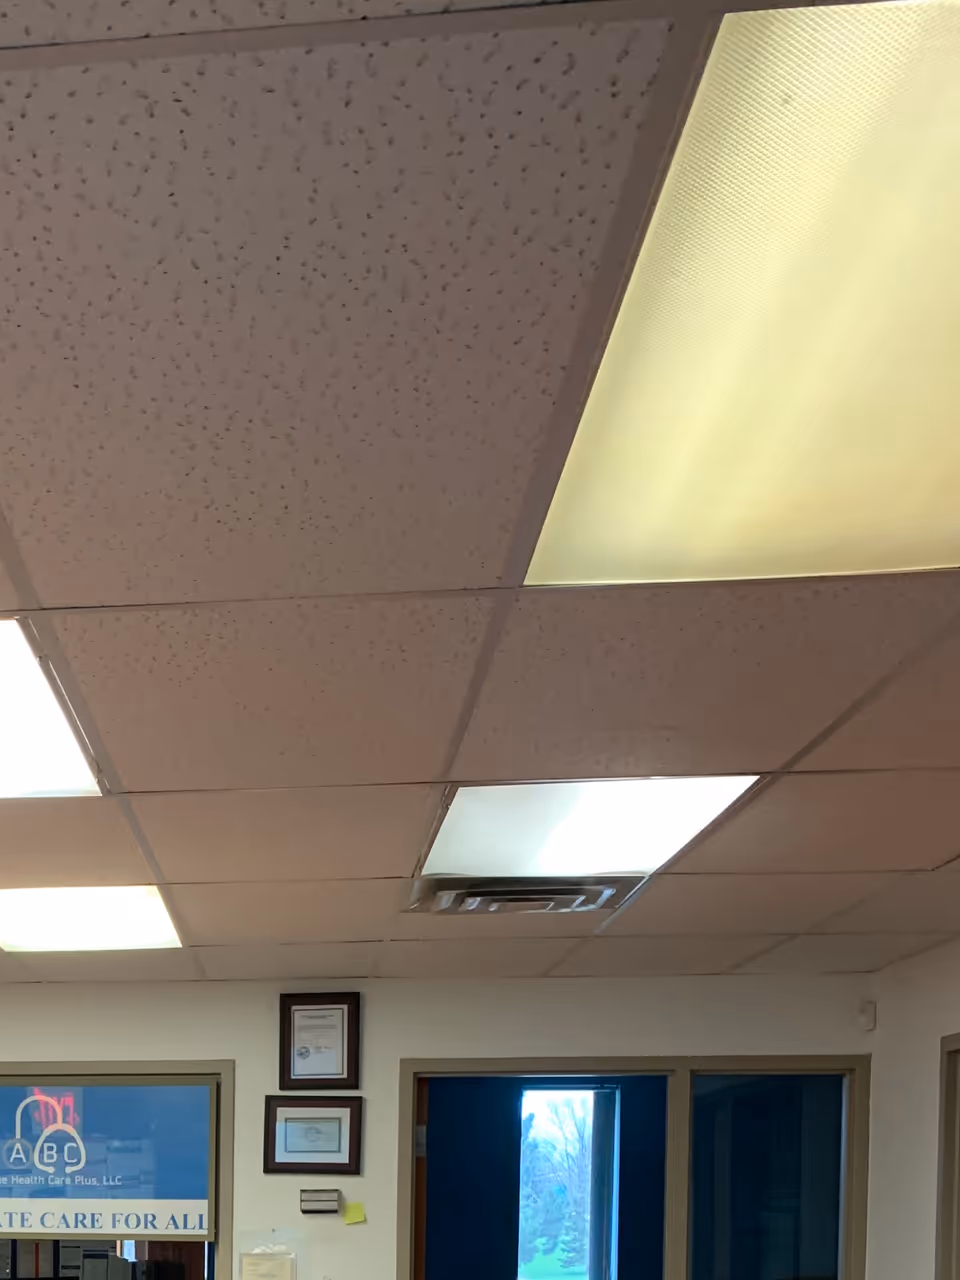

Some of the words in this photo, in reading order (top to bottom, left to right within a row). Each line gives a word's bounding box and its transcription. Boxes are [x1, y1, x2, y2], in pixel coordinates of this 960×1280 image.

[9, 1142, 78, 1164] ABC
[11, 1174, 45, 1185] Health
[47, 1174, 71, 1186] Care
[74, 1175, 100, 1187] Plus,
[102, 1175, 123, 1186] LLC
[40, 1211, 103, 1229] CARE
[111, 1212, 158, 1230] FOR
[164, 1213, 208, 1231] ALL
